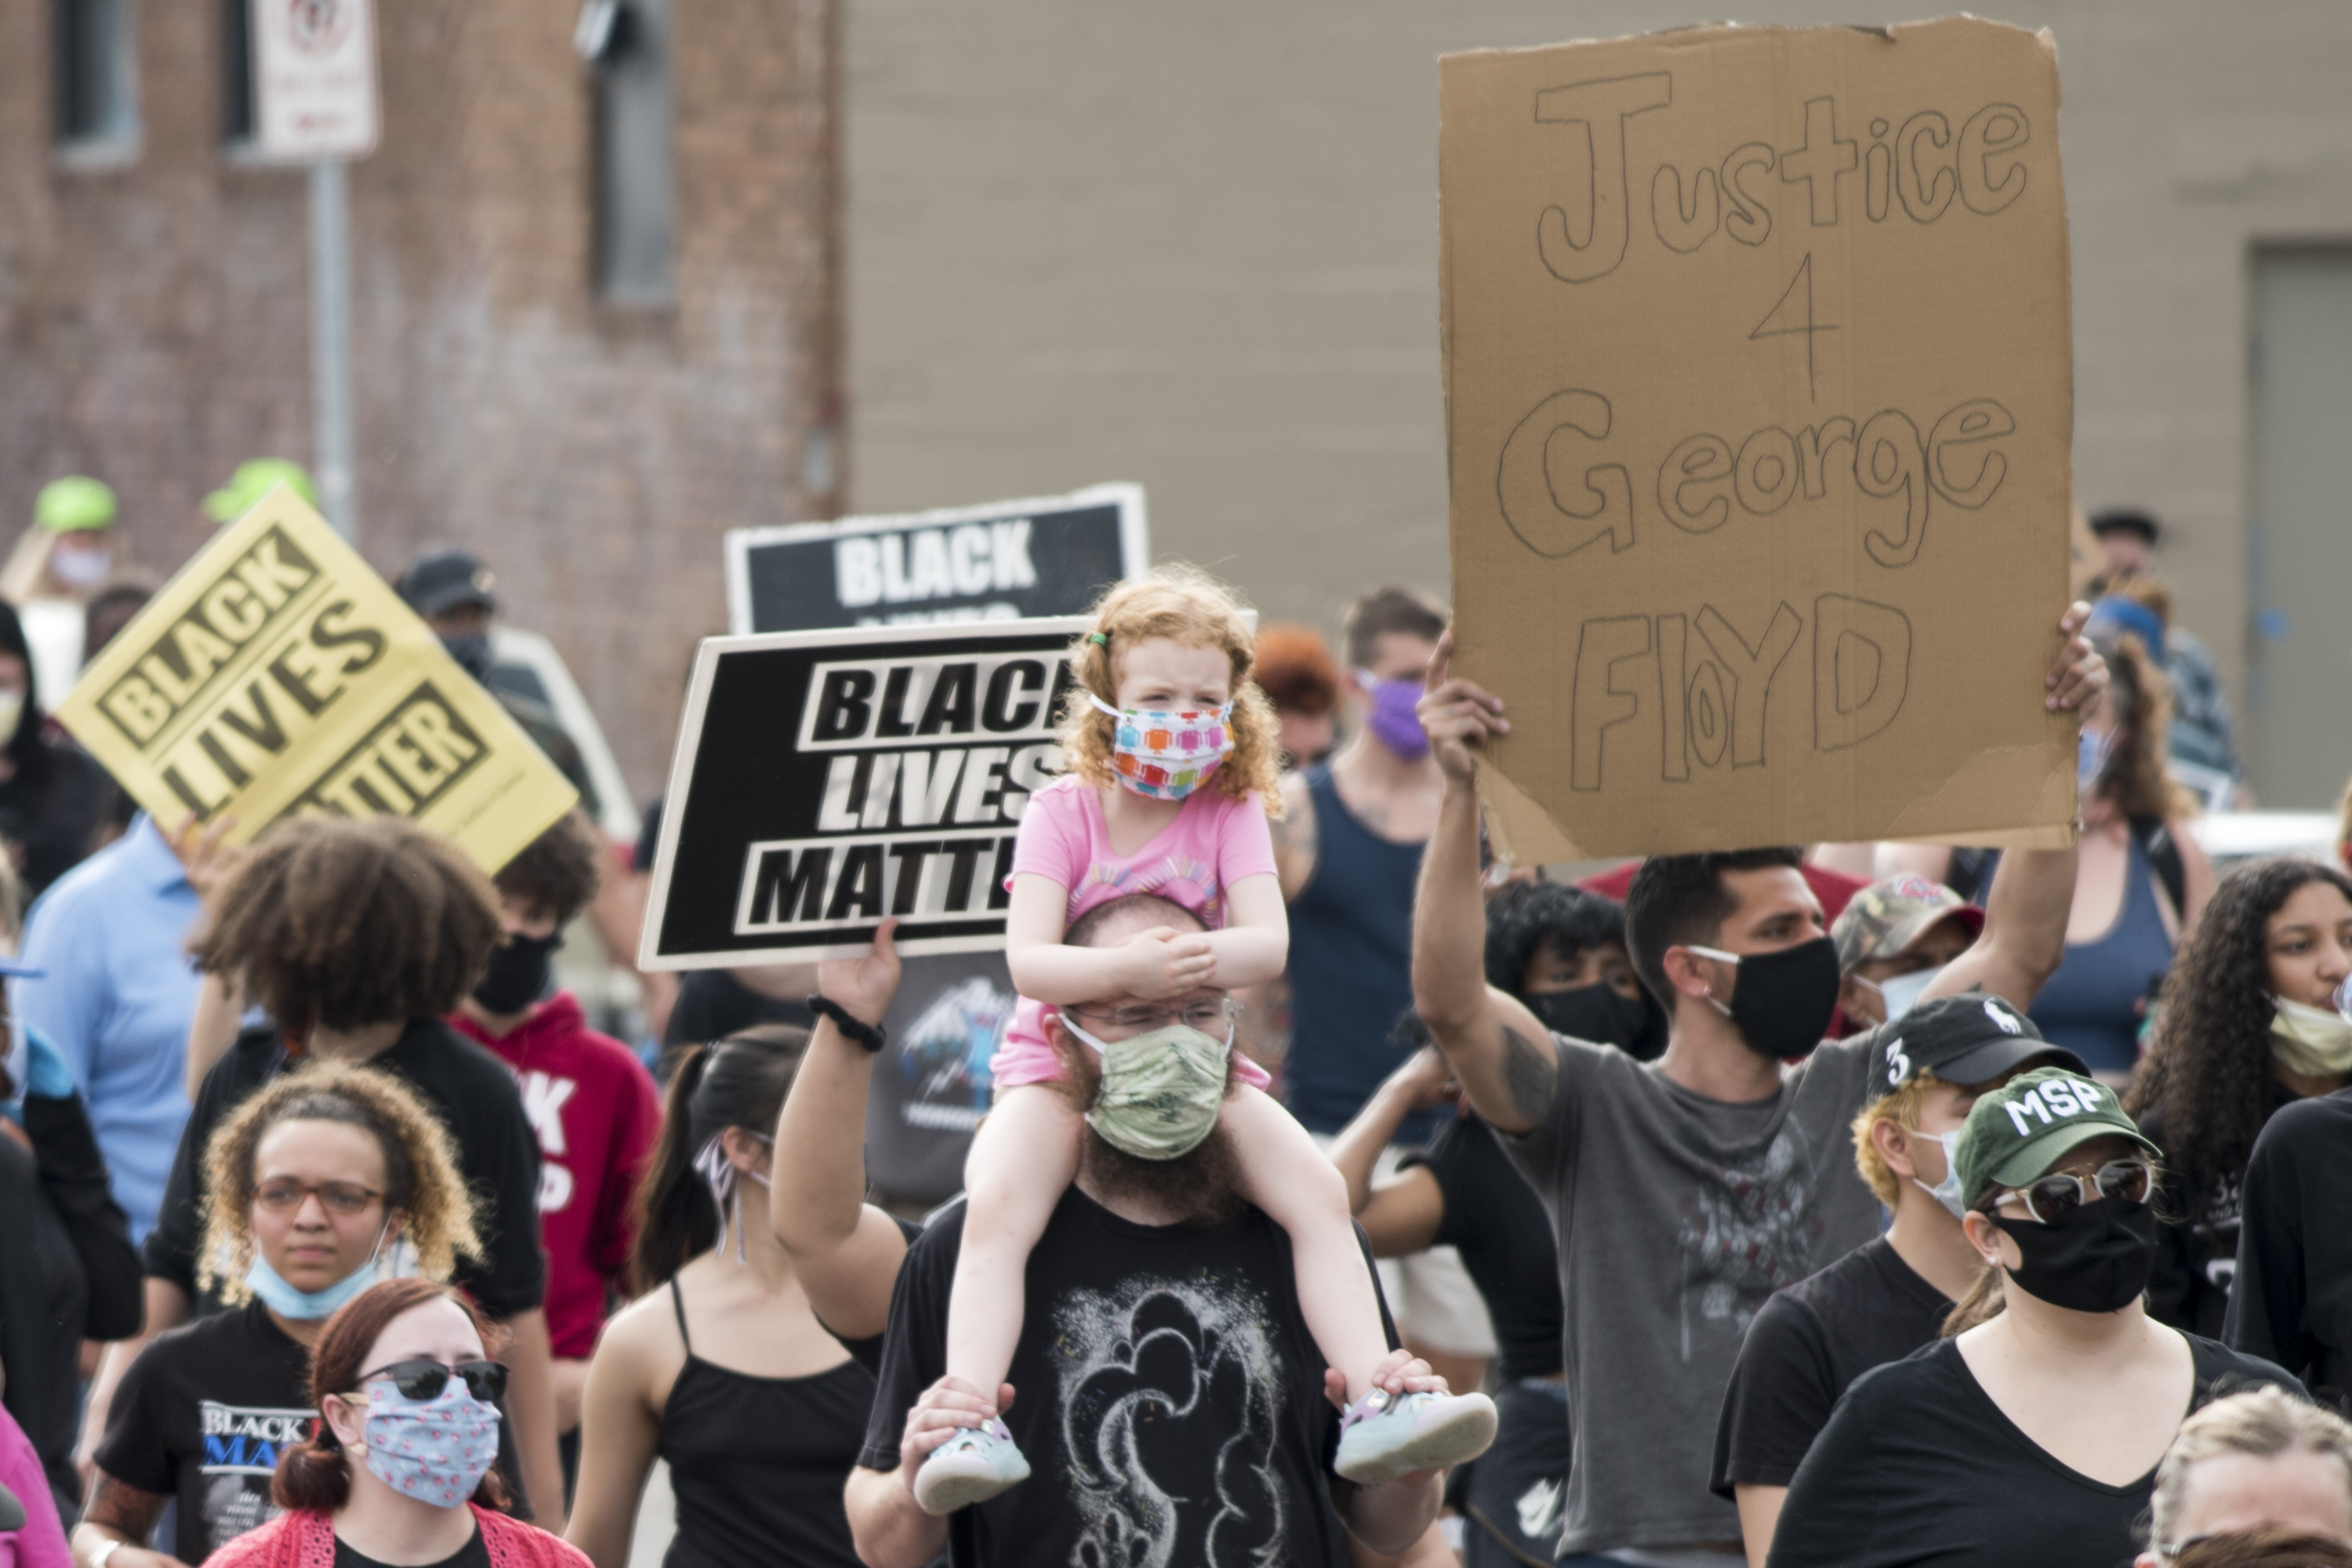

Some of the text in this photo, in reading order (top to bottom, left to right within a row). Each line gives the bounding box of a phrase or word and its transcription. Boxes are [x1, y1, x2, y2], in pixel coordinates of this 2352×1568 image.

[1535, 71, 2029, 284] Justice
[1748, 251, 1838, 404] 4
[1498, 389, 2016, 568] George
[837, 519, 1037, 608] BLACK
[104, 535, 312, 739] BLACK
[162, 599, 389, 823] LIVES
[296, 699, 480, 817] TTER
[1886, 1036, 1911, 1086] 3
[2004, 1078, 2103, 1137] MSP
[201, 1410, 306, 1443] BLACK
[203, 1436, 285, 1467] MA
